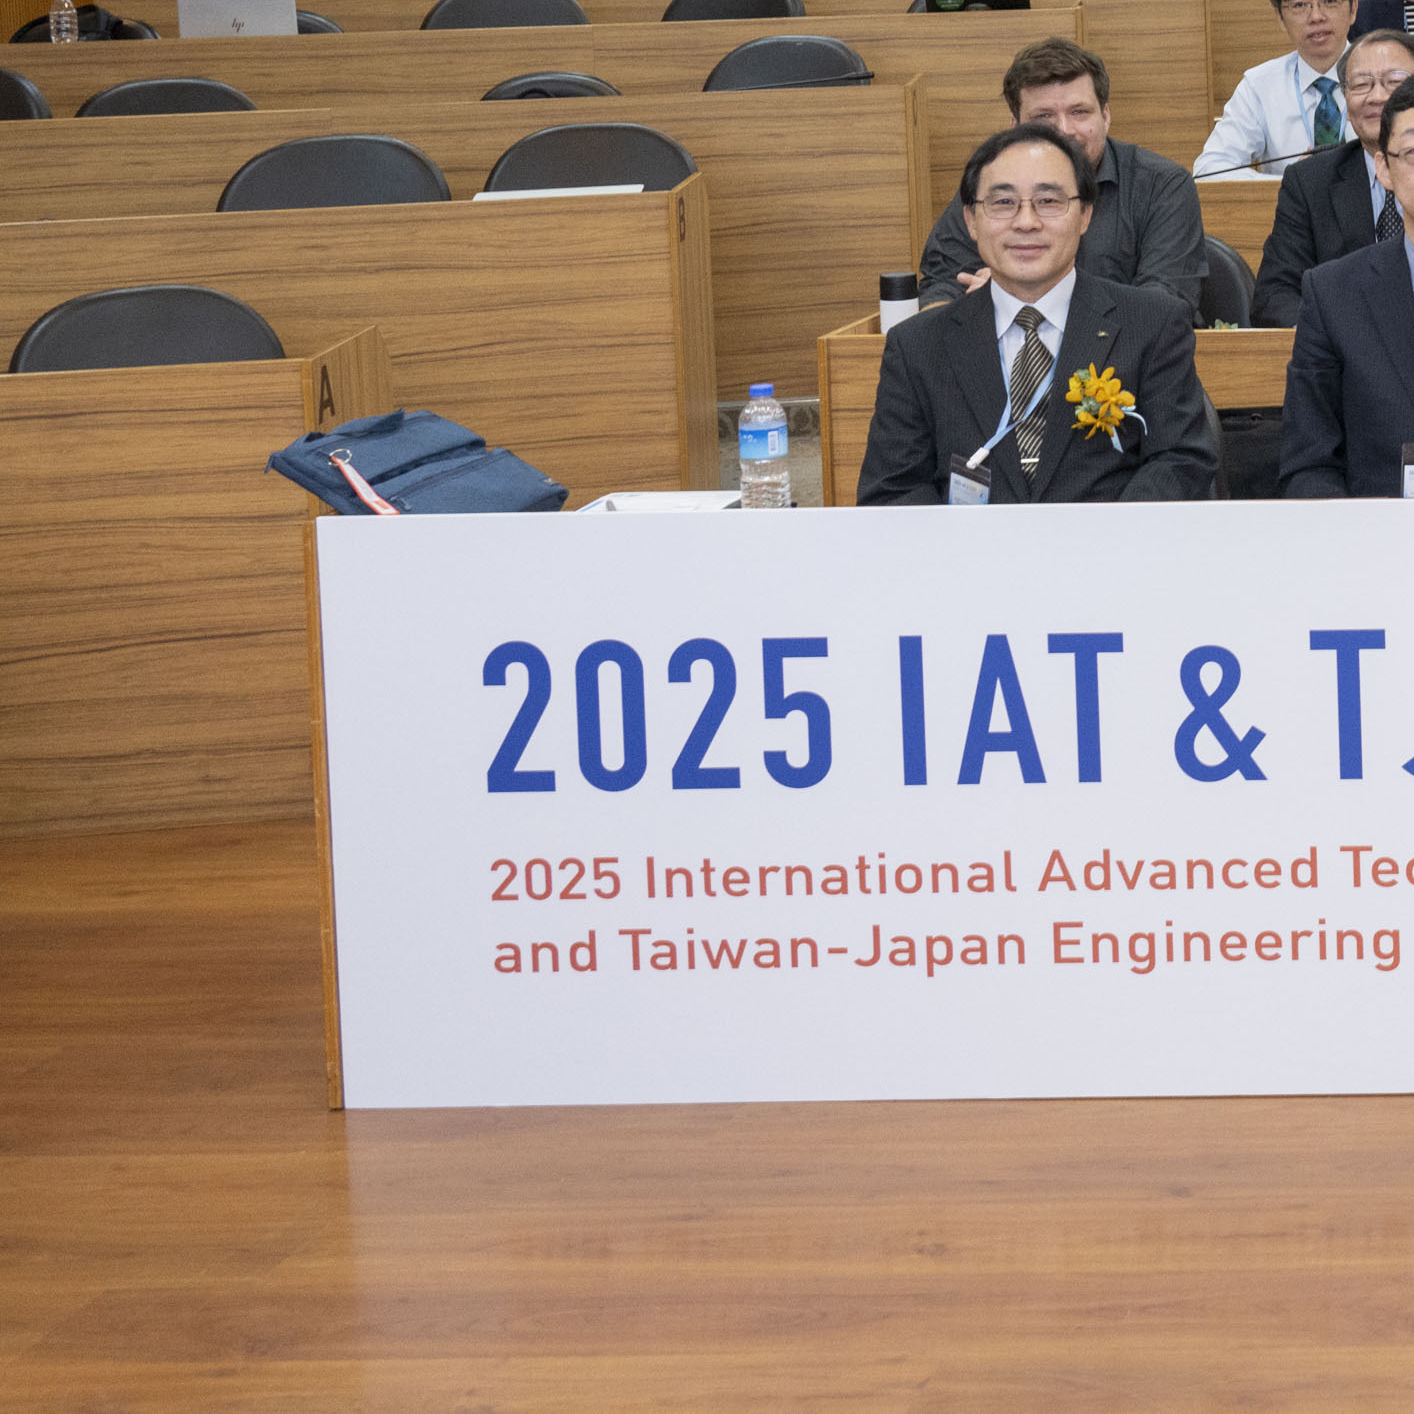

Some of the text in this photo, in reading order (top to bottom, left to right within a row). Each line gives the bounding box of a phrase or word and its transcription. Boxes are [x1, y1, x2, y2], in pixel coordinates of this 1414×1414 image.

[678, 196, 686, 243] B
[319, 364, 335, 424] A
[482, 636, 833, 794] 2025
[898, 631, 1124, 787] IAT
[1173, 644, 1268, 783] &
[490, 856, 621, 902] 2025
[646, 849, 1018, 899] International
[1037, 845, 1319, 892] Advanced
[493, 929, 598, 974] and
[617, 924, 1026, 978] Taiwan-Japan
[1052, 918, 1401, 975] Engineering
